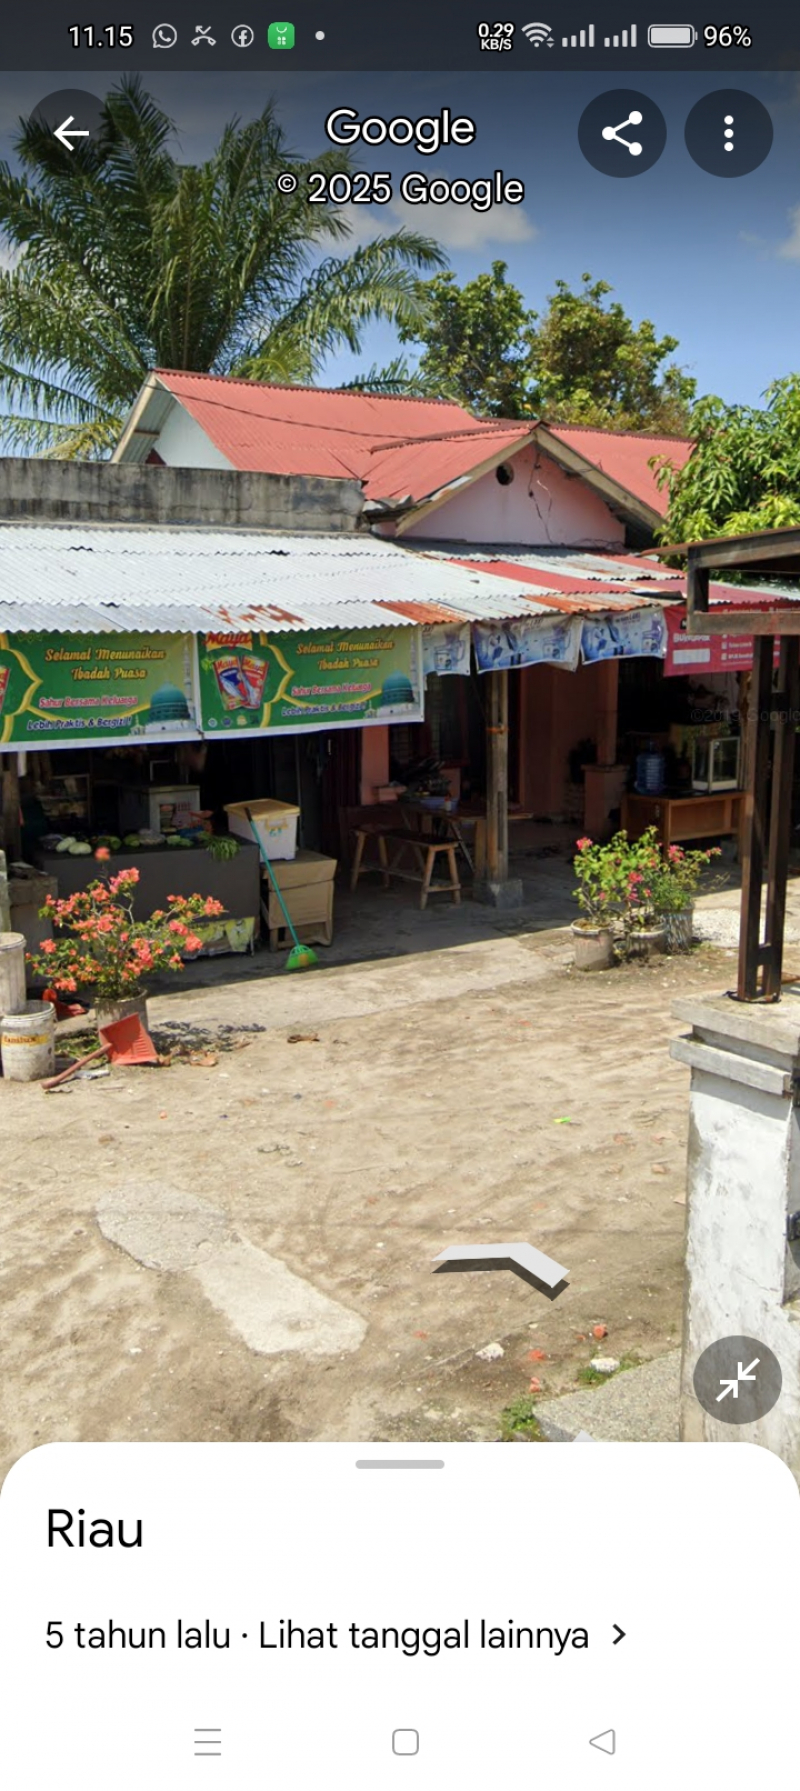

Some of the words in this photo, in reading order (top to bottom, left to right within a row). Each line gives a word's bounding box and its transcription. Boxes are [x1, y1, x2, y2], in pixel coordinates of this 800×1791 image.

[336, 639, 395, 652] Menunaikan
[95, 646, 167, 661] Menunaikan
[318, 659, 350, 671] Ibadah
[352, 658, 380, 669] Puasa
[71, 667, 110, 680] Ibadah
[114, 667, 147, 680] Puasa
[27, 719, 53, 731] Lebih
[55, 719, 85, 730] Praktis
